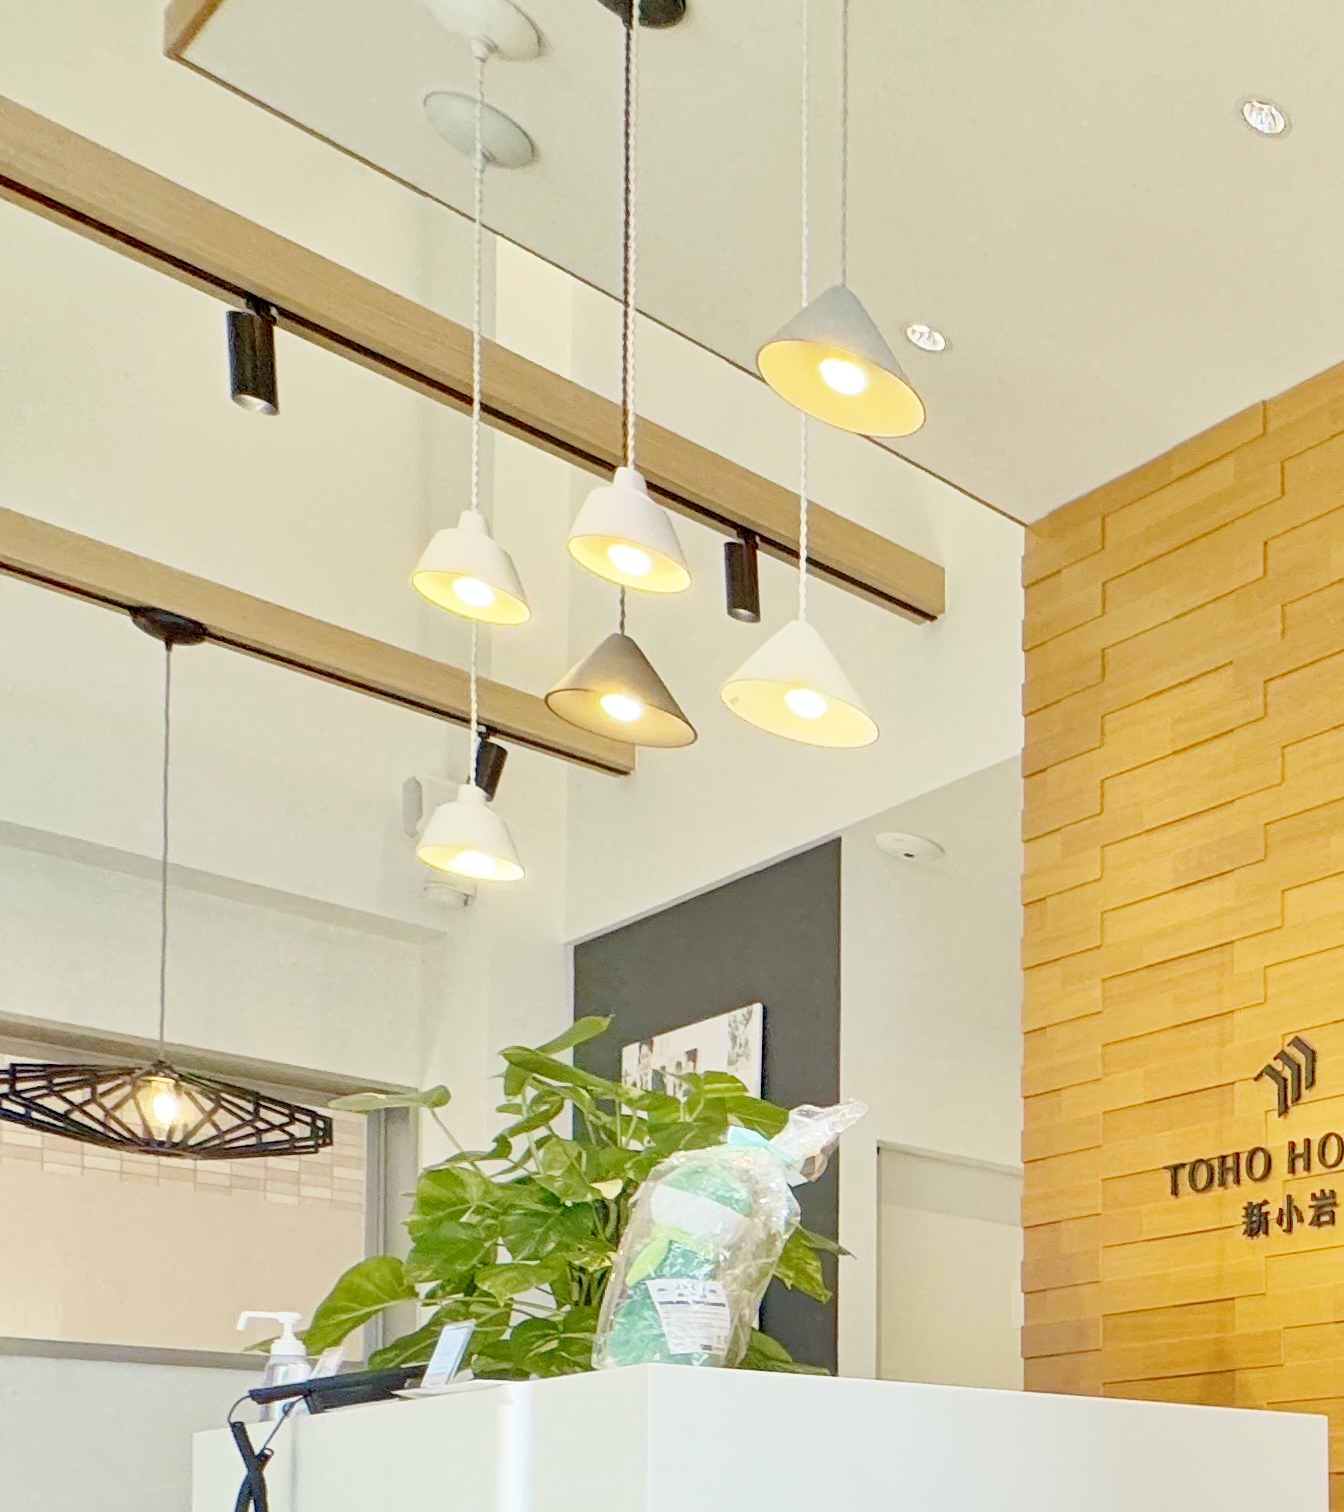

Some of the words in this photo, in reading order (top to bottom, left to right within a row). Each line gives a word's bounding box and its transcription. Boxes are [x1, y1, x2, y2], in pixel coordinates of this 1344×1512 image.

[1164, 1146, 1273, 1198] TOHO
[1241, 1189, 1340, 1238] 新小岩
